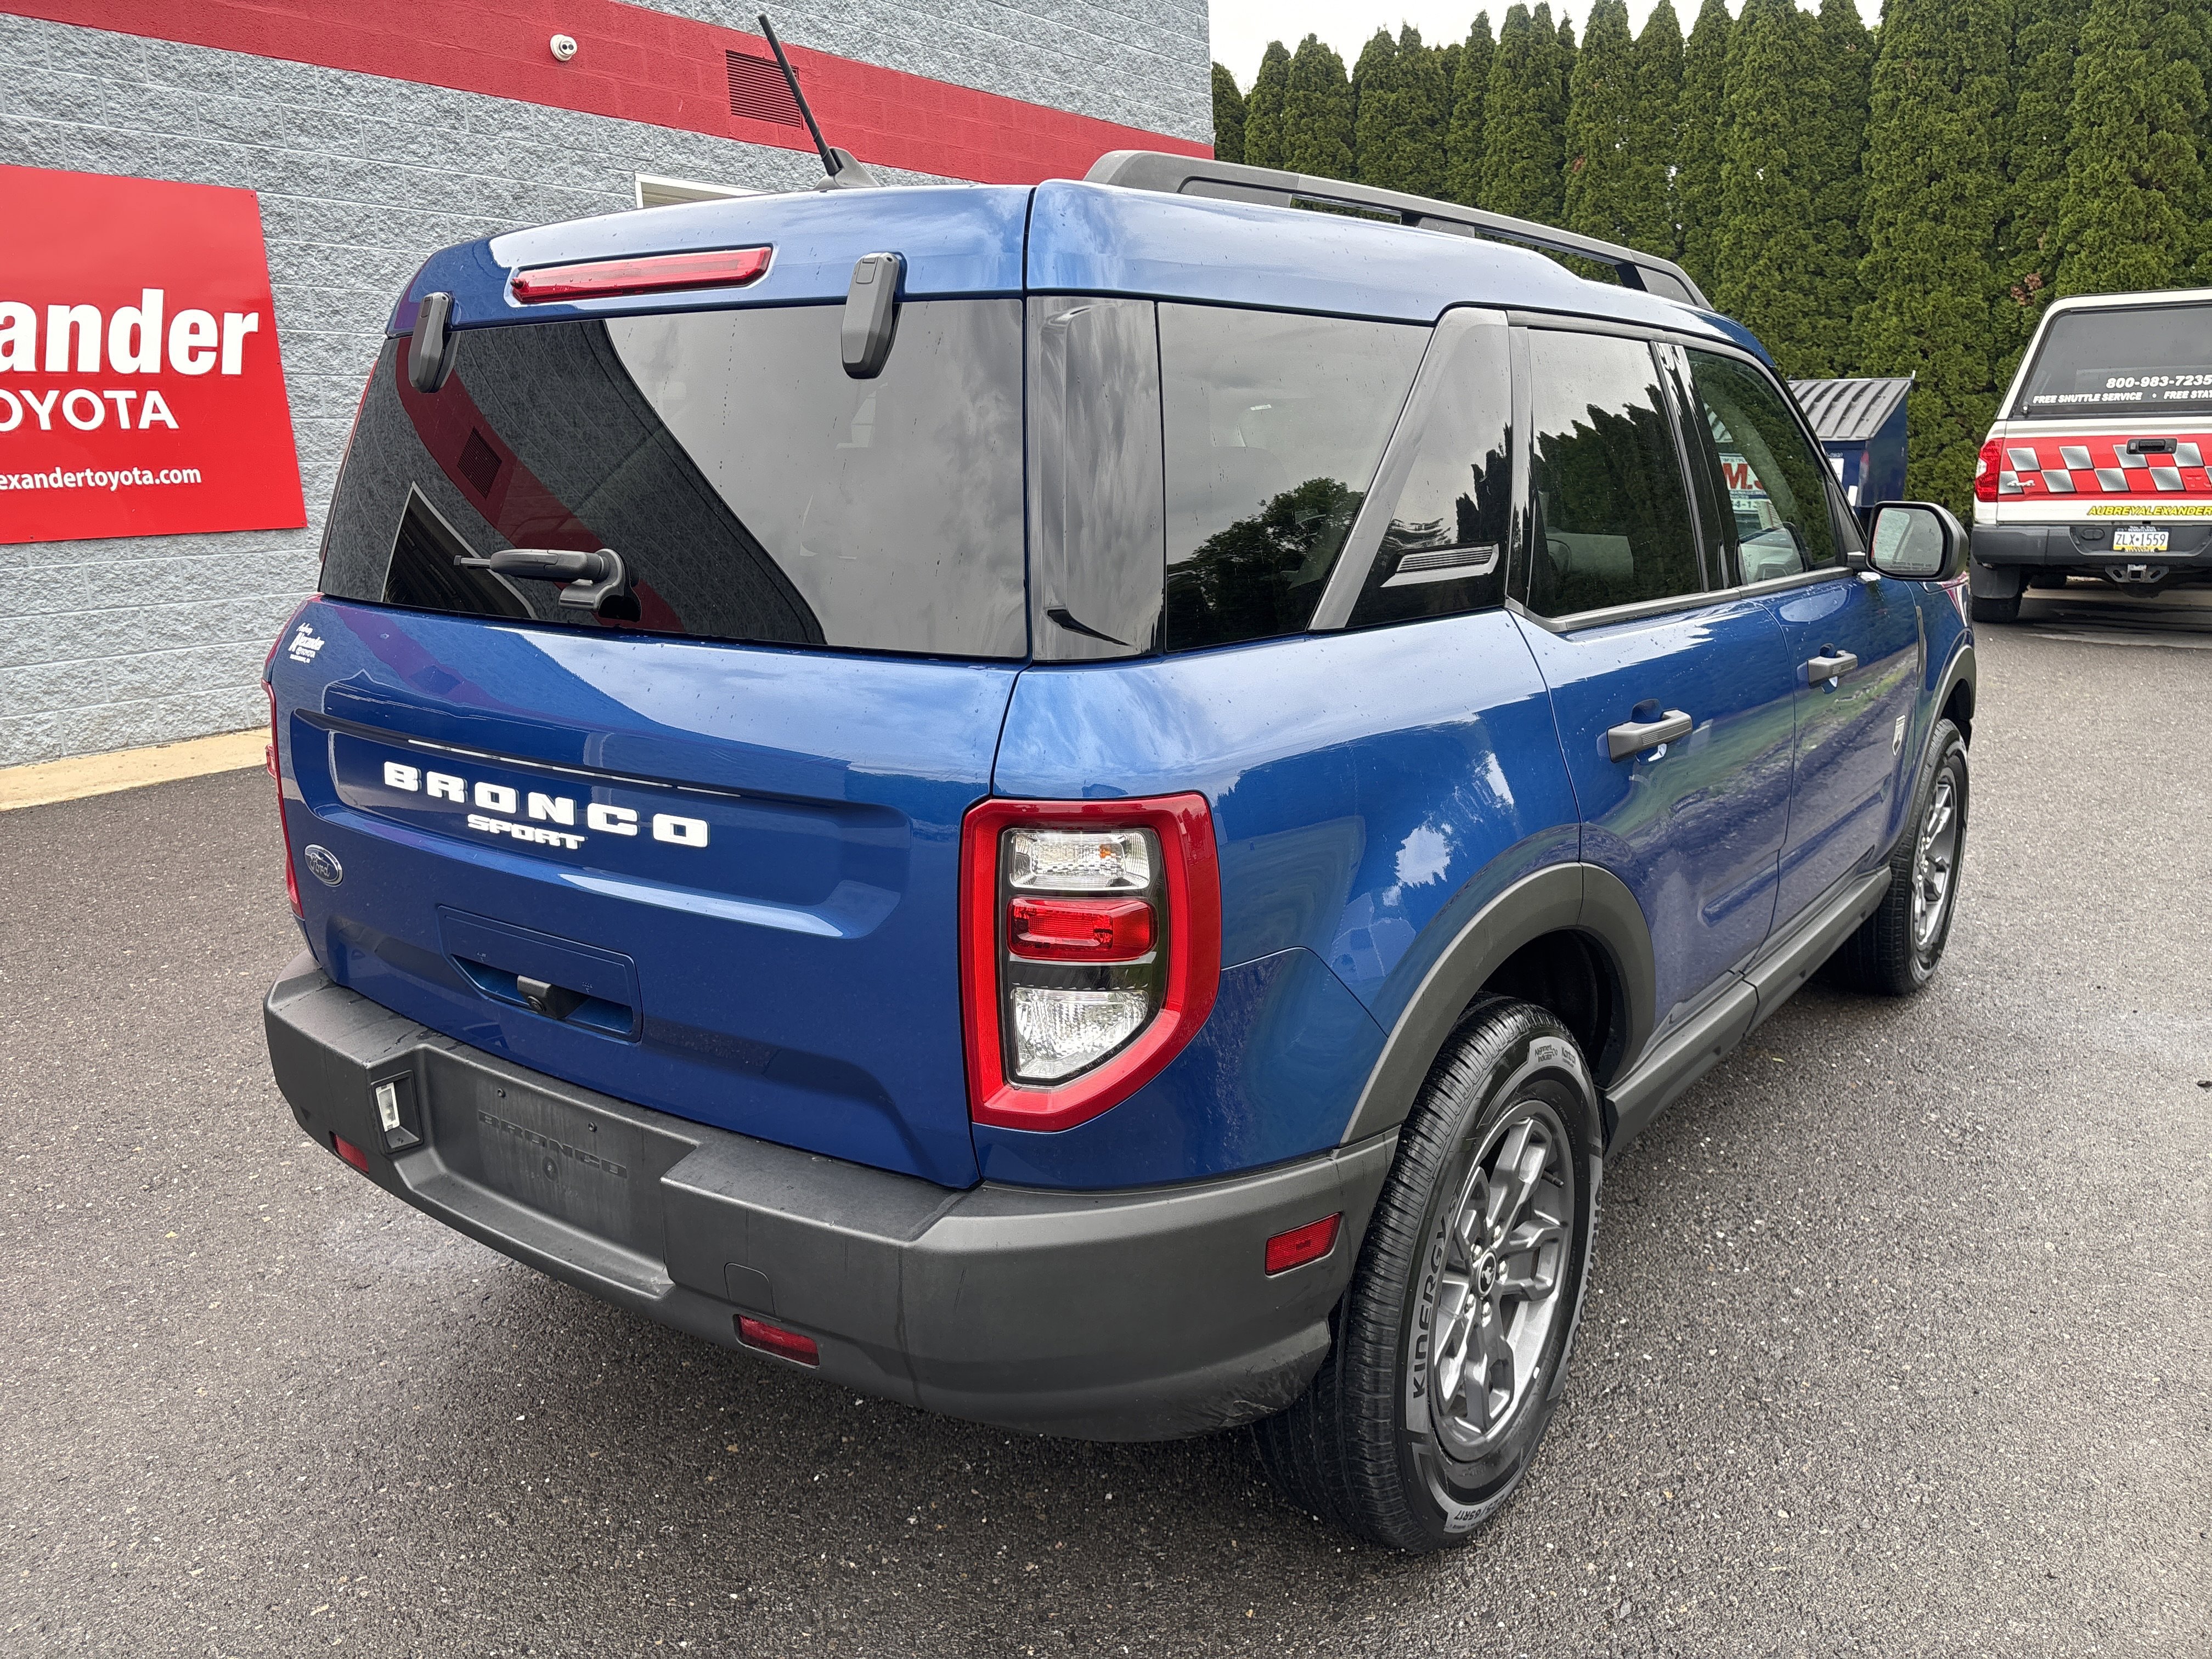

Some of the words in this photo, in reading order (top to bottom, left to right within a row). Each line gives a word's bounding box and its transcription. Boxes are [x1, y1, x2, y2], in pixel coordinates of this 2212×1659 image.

[2033, 395, 2057, 403] FREE
[2058, 393, 2101, 403] SHUTTLE
[2101, 392, 2143, 401] SERVICE
[2164, 391, 2190, 399] FREE
[2106, 375, 2212, 388] 800-983-7235
[383, 761, 710, 848] BRONCO
[467, 814, 589, 850] SPORT
[309, 852, 331, 878] Ford
[477, 1110, 628, 1179] BRONCO
[1413, 1215, 1447, 1400] KINERGY
